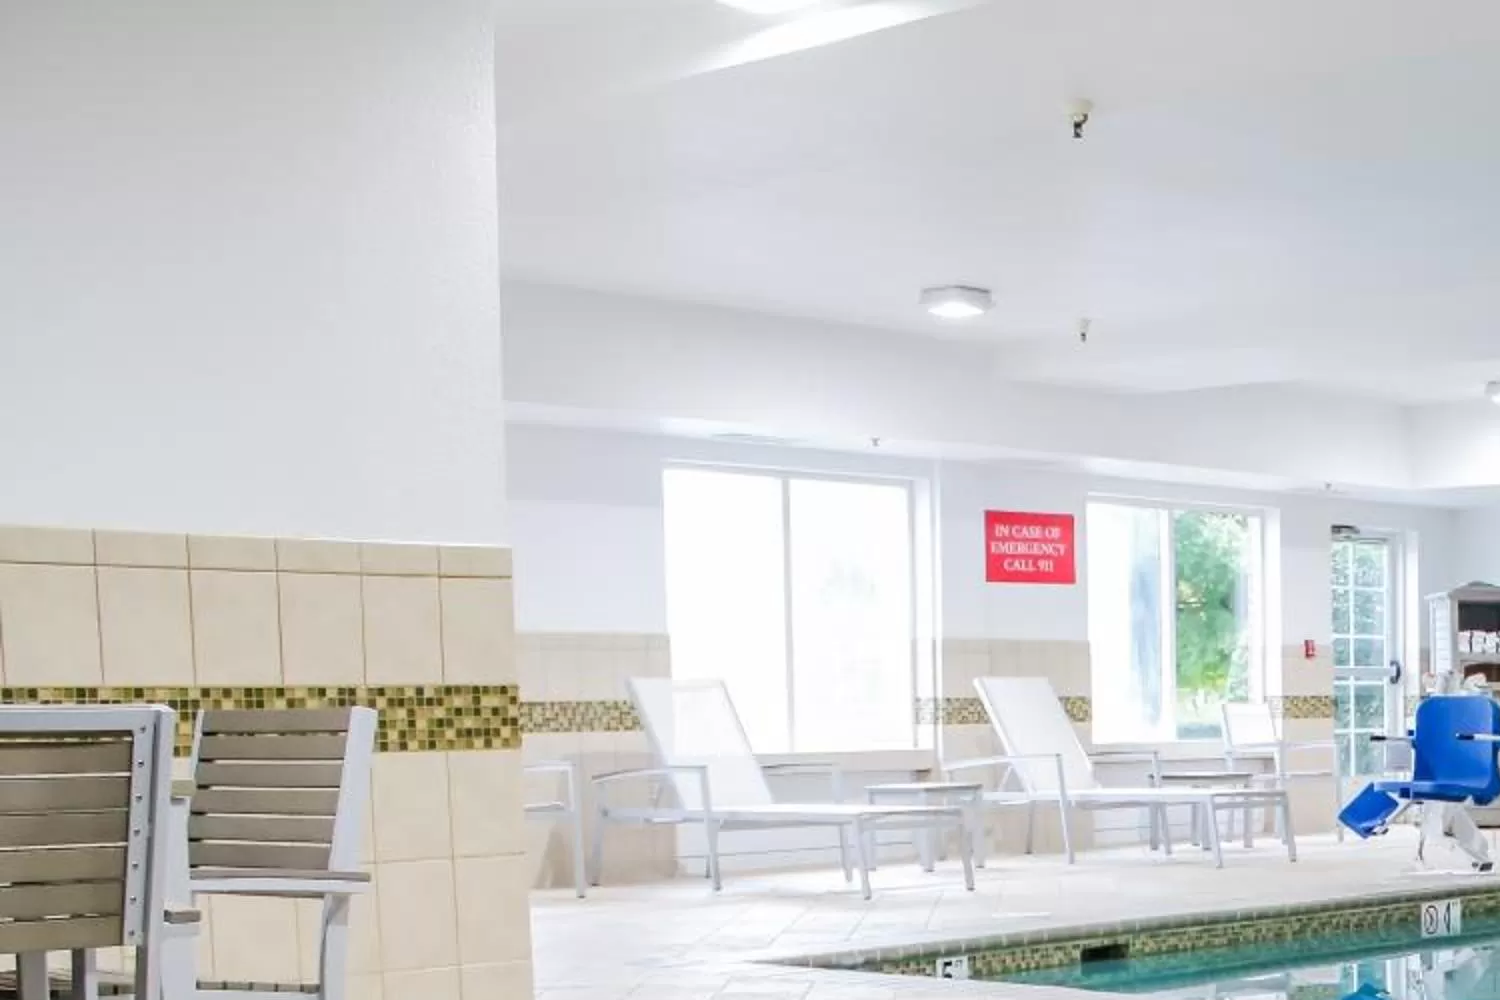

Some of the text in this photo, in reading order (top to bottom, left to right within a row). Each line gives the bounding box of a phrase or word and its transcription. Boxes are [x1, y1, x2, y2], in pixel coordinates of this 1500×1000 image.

[994, 524, 1062, 540] IN CASE OF
[991, 541, 1066, 556] EMERGENCY
[1003, 559, 1054, 573] CALL 911
